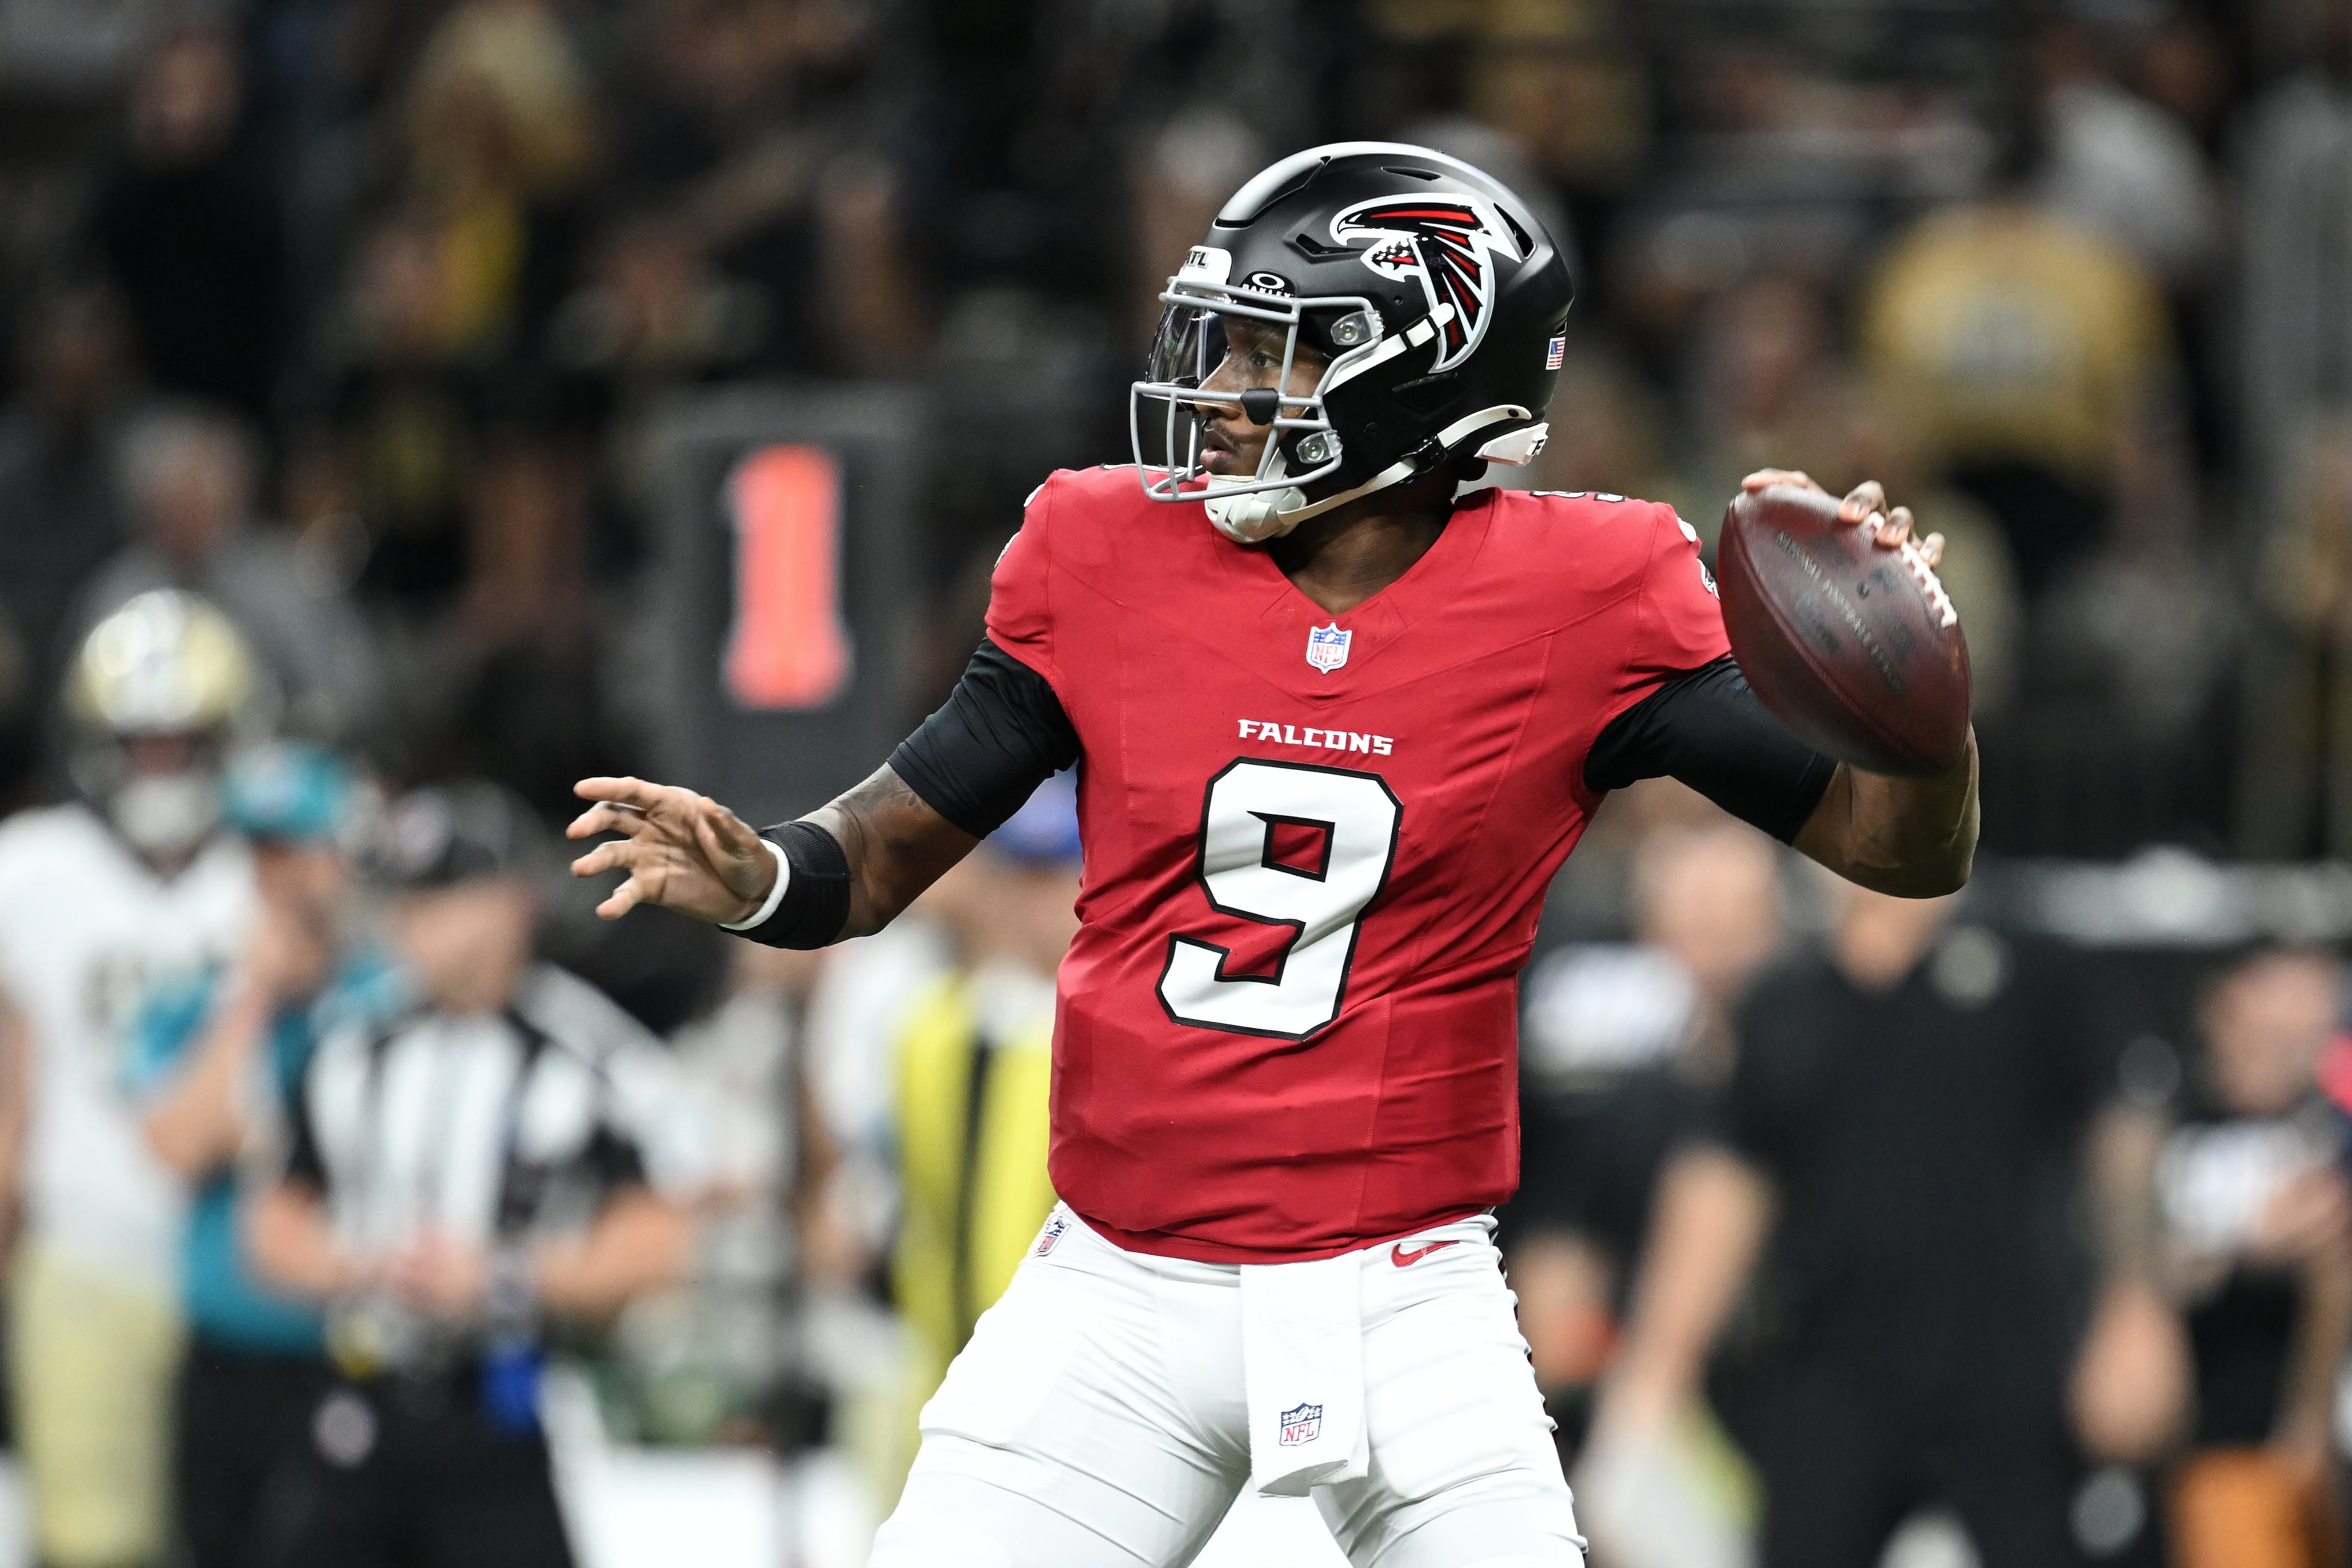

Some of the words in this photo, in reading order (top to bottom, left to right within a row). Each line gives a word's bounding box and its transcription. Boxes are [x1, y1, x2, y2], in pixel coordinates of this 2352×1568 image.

[1314, 644, 1340, 664] NFL
[1237, 719, 1394, 756] FALCONS
[1155, 756, 1405, 1041] 9
[1283, 1422, 1314, 1442] NFL
